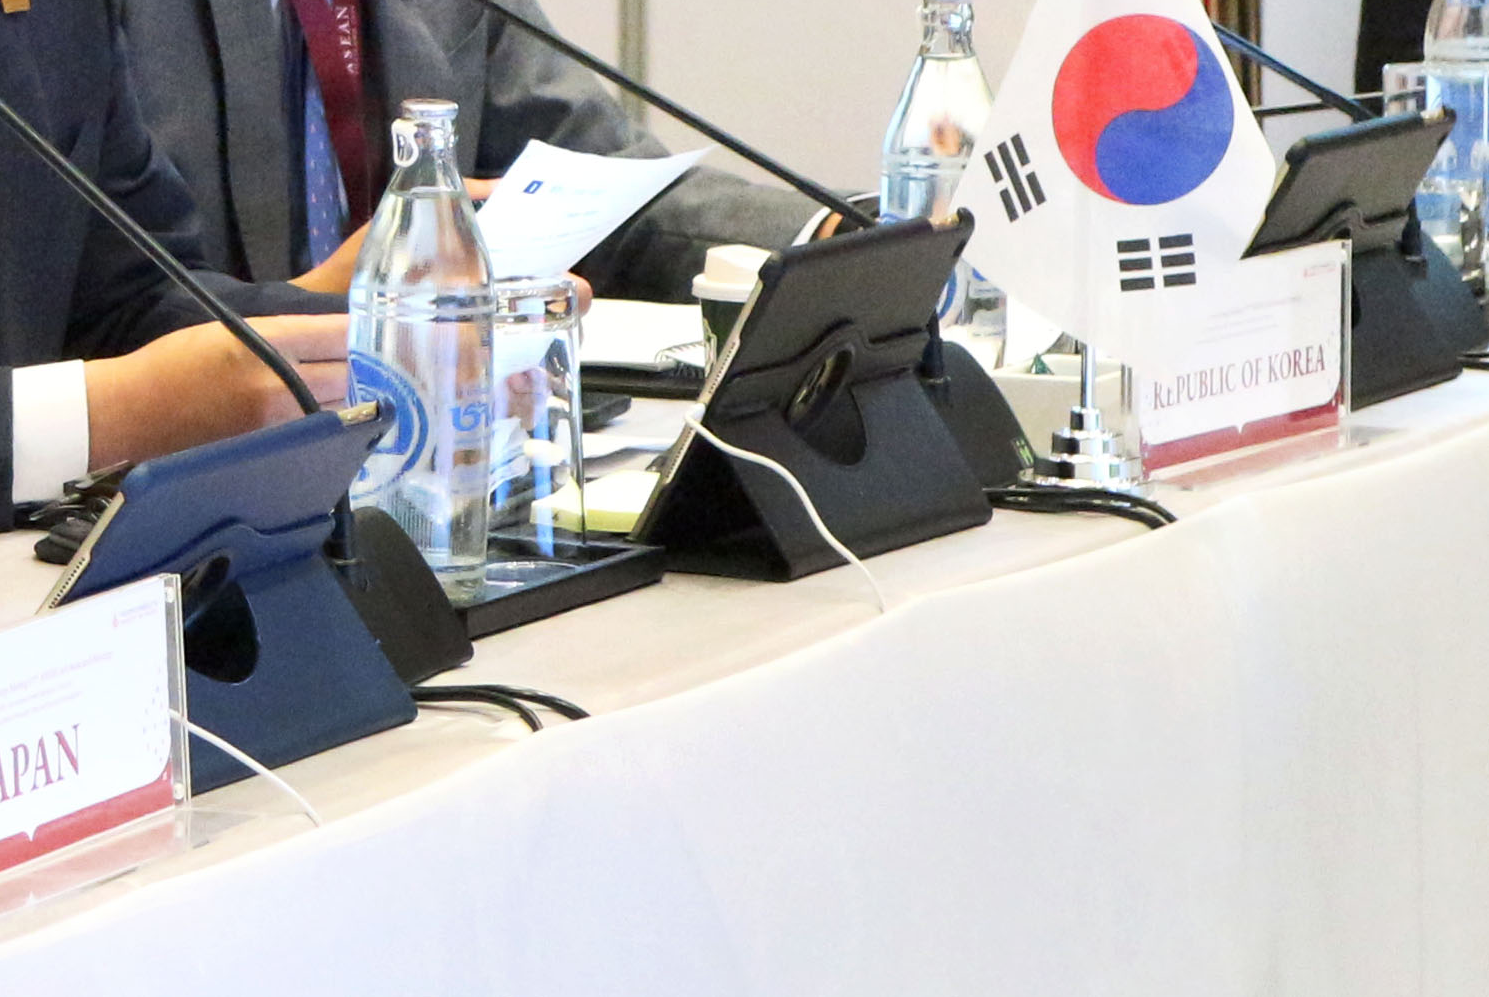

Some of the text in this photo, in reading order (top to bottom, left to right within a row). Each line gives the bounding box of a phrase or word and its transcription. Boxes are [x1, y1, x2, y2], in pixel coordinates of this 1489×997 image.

[1153, 344, 1326, 411] REPUBLIC OF KOREA
